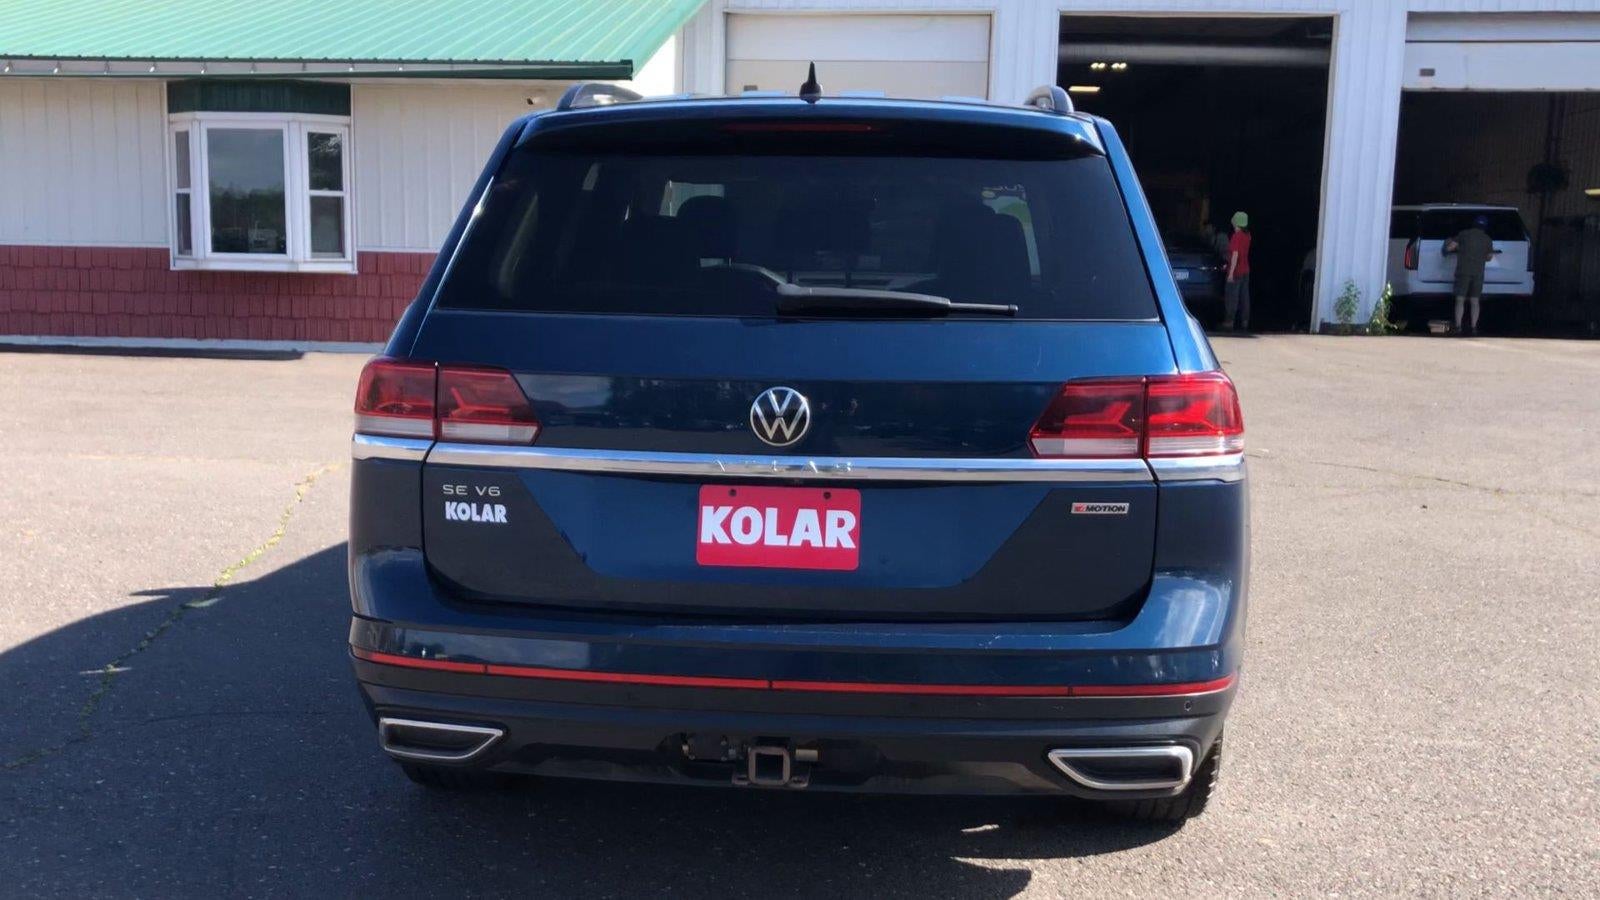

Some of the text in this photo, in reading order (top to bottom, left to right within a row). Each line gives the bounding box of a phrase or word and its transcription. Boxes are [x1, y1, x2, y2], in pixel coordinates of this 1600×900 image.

[442, 484, 501, 497] SE V6
[445, 501, 507, 523] KOLAR
[700, 505, 857, 549] KOLAR
